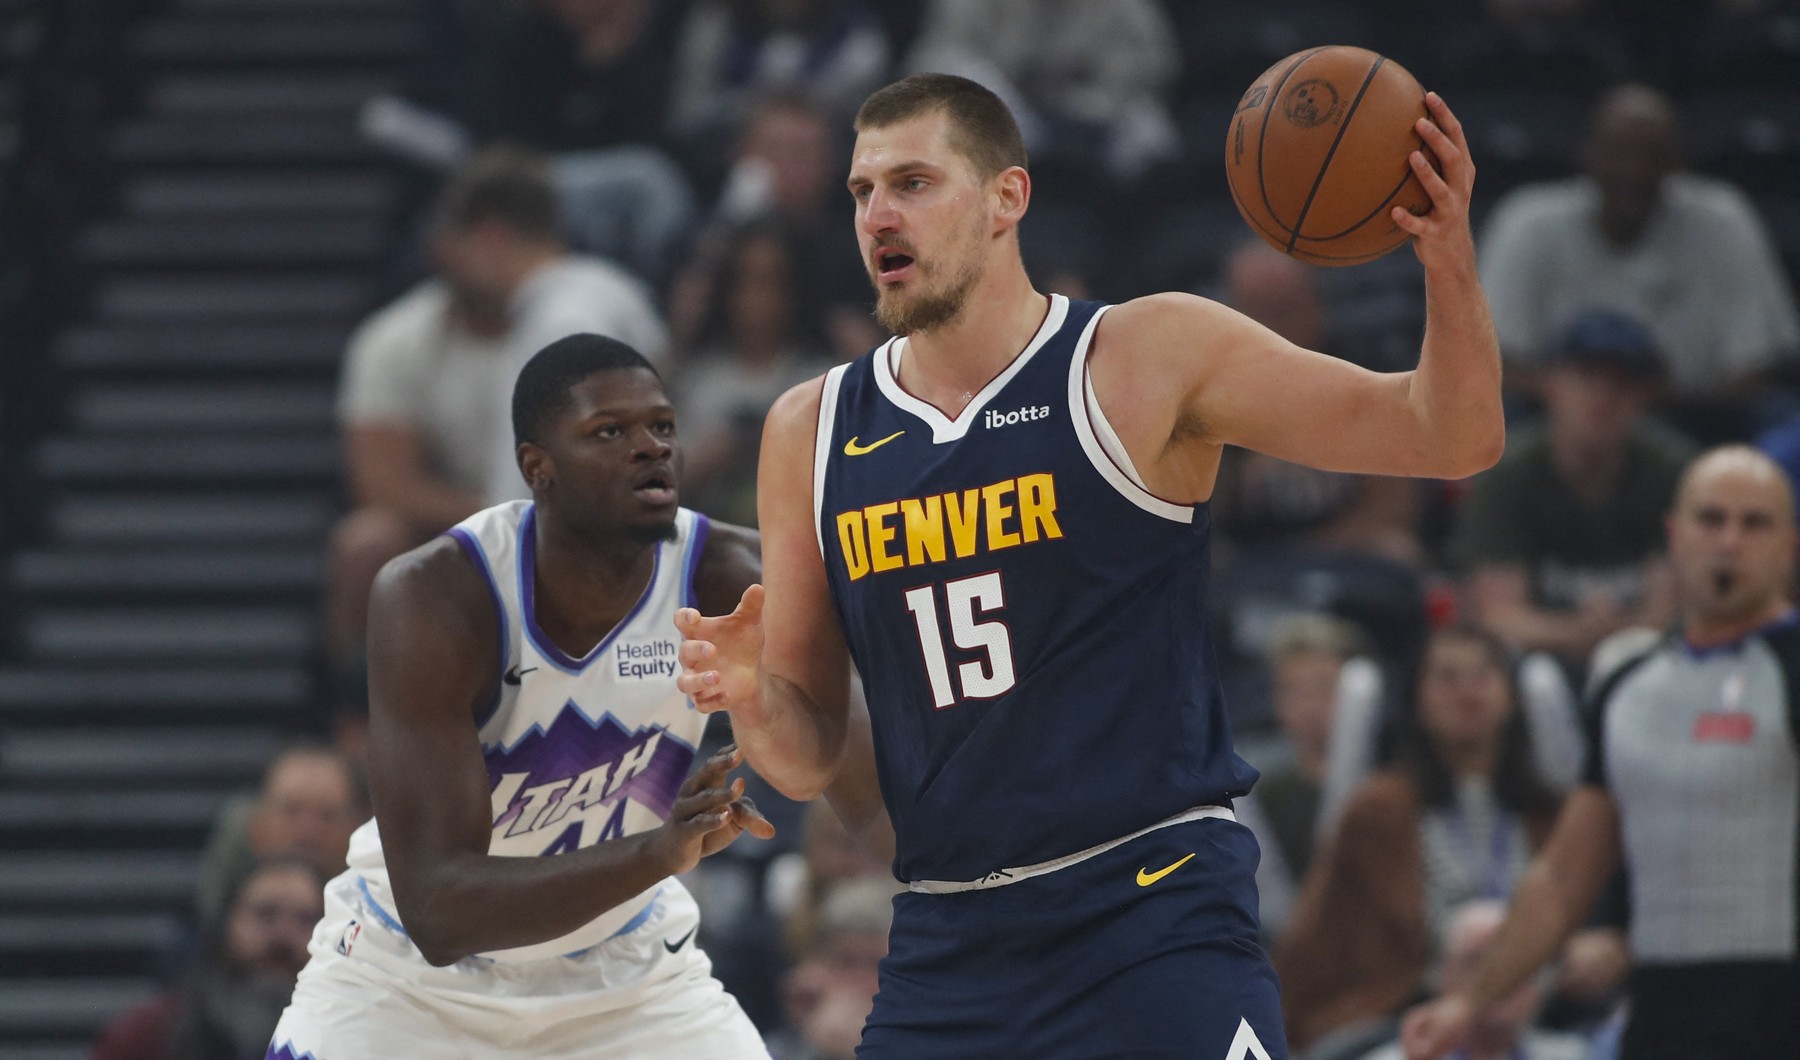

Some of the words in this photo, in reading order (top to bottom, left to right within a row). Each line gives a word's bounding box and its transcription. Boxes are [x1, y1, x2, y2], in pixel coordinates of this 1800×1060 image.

[985, 405, 1050, 429] ibotta
[836, 472, 1064, 581] DENVER
[616, 640, 675, 660] Health
[904, 570, 1016, 709] 15
[618, 659, 676, 680] Equity
